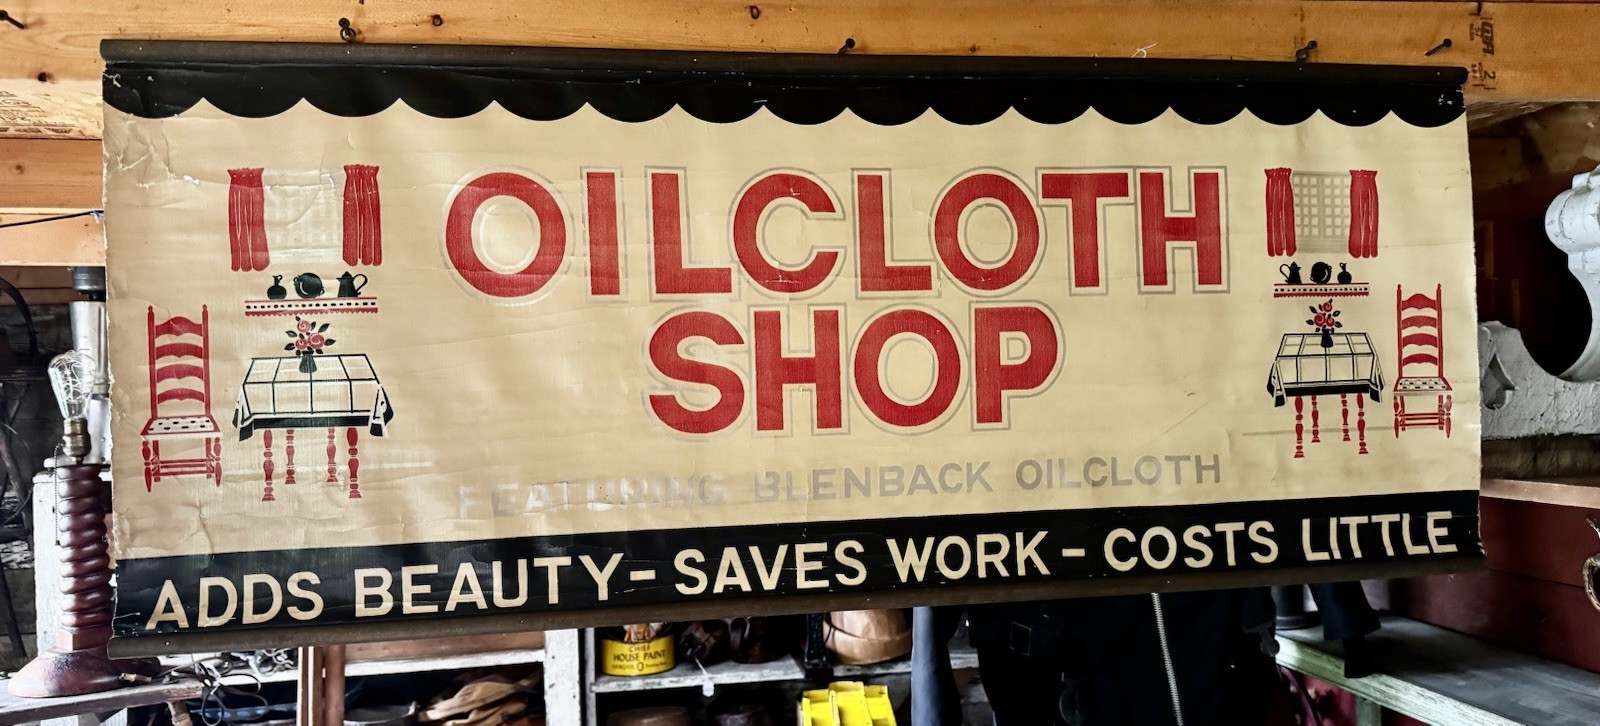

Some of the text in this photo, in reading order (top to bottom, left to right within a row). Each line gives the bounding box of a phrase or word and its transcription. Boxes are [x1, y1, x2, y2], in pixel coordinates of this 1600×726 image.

[445, 171, 1223, 298] OILCLOTH
[648, 306, 1058, 434] SHOP
[458, 453, 1222, 519] FEATURING BLENBACK OILCLOTH
[144, 569, 324, 631] ADDS
[673, 540, 868, 595] SAVES
[885, 529, 1051, 583] WORK
[1103, 521, 1279, 572] COSTS
[1302, 510, 1458, 561] LITTLE
[613, 650, 665, 661] HOUSE PAINT
